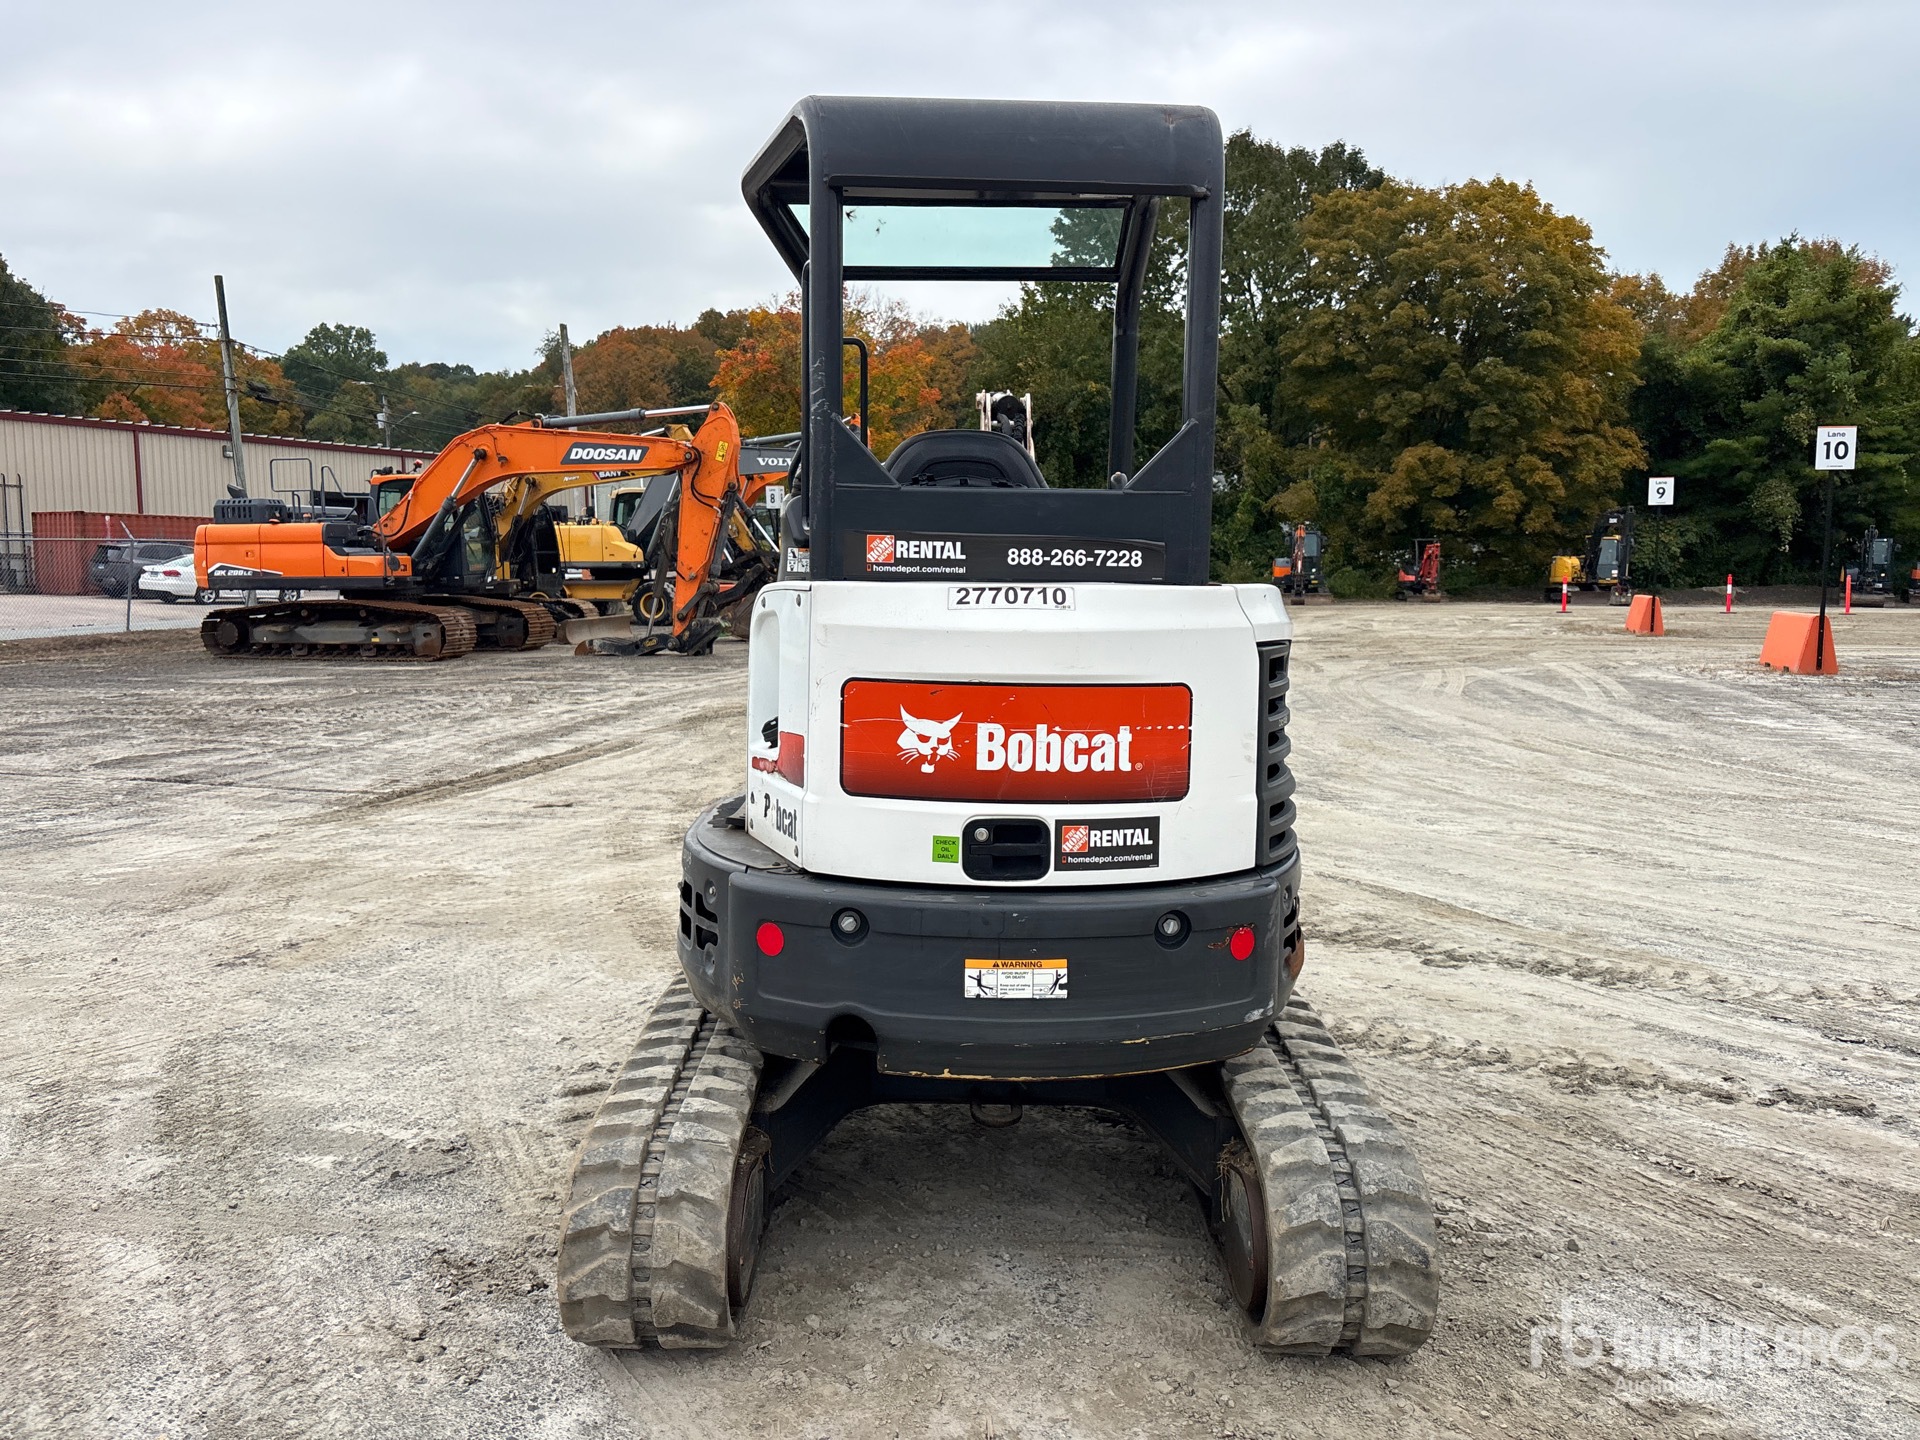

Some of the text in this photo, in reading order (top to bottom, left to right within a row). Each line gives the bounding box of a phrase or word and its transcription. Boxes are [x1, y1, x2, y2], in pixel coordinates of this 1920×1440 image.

[570, 448, 642, 461] DOOSAN
[1823, 441, 1849, 460] 10
[756, 457, 792, 466] VOLV
[770, 493, 776, 504] 8
[1656, 486, 1666, 499] 9
[867, 535, 894, 562] HOME
[878, 546, 894, 562] DEPOT
[896, 540, 967, 559] RENTAL
[1007, 548, 1143, 567] 888-266-7228
[873, 565, 966, 574] homedepot.com/rental
[956, 587, 1067, 605] 2770710
[976, 722, 1133, 773] Bobcat
[1062, 826, 1089, 852] HOME
[1072, 836, 1089, 852] DEPOT
[1090, 828, 1153, 847] RENTAL
[1068, 853, 1153, 864] homedepot.com/rental
